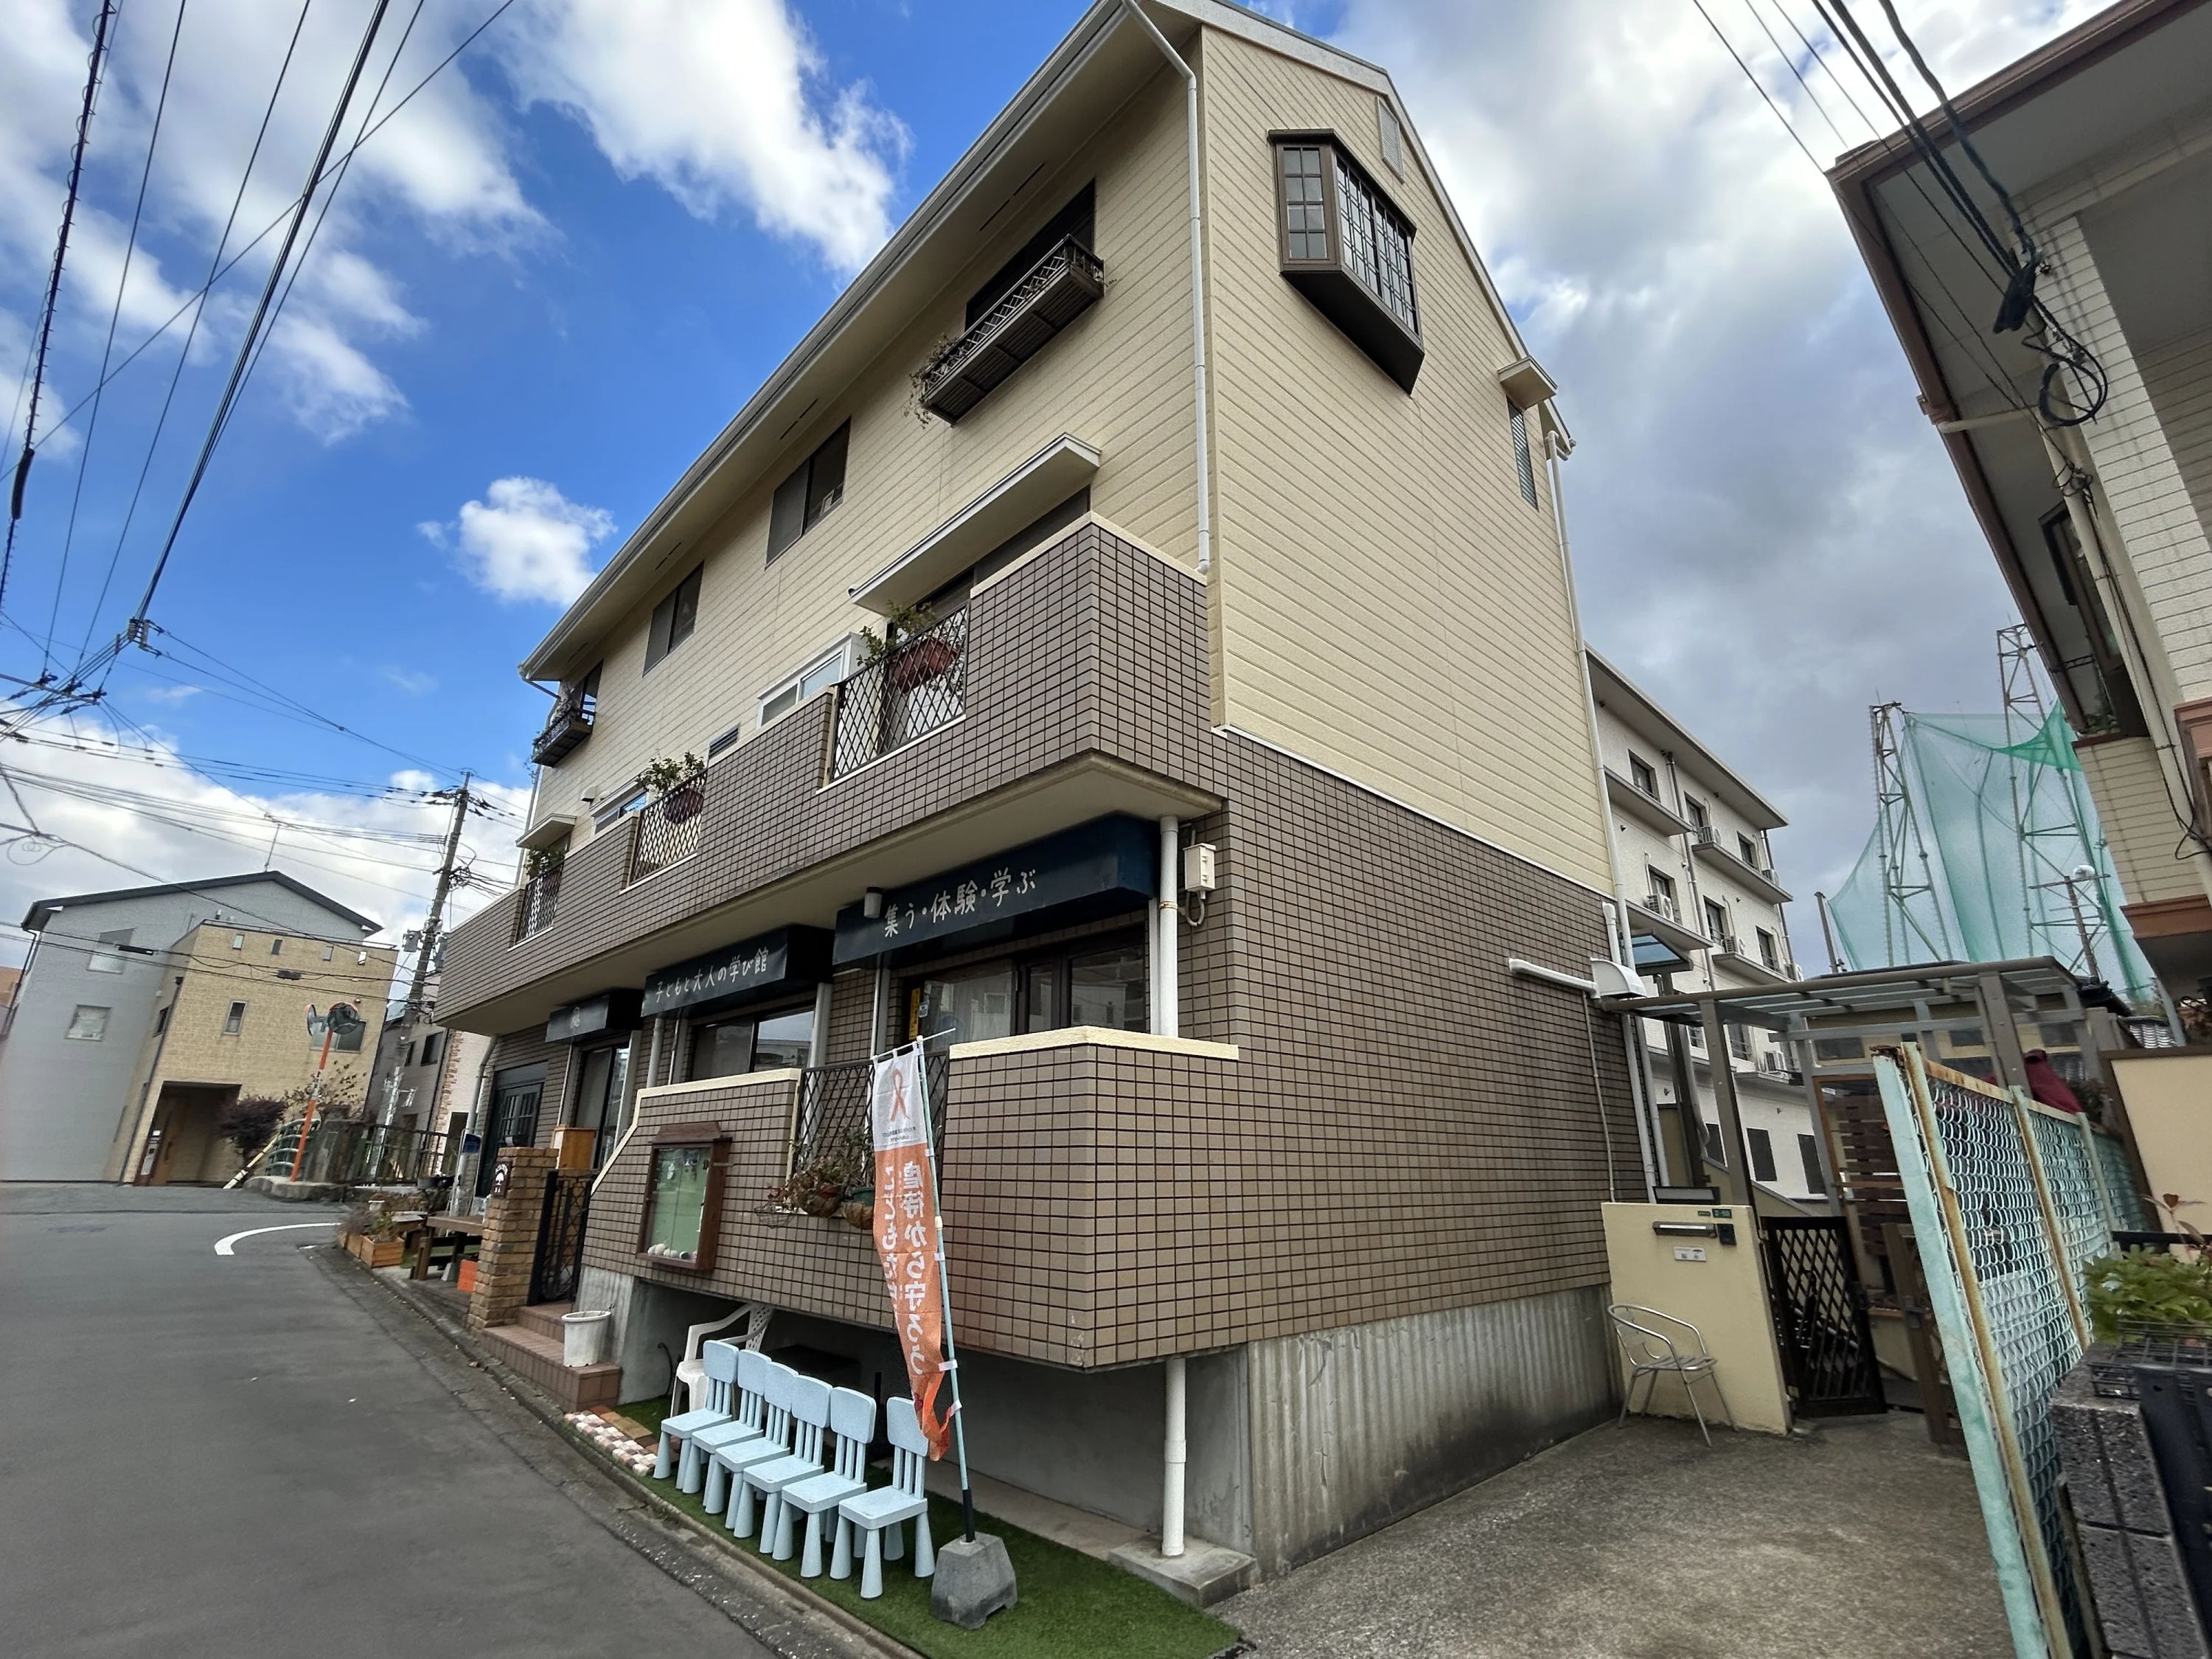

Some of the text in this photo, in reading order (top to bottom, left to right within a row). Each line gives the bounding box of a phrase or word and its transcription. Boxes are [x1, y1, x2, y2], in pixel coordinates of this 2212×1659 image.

[655, 947, 769, 1003] 子どもと大人の学び館
